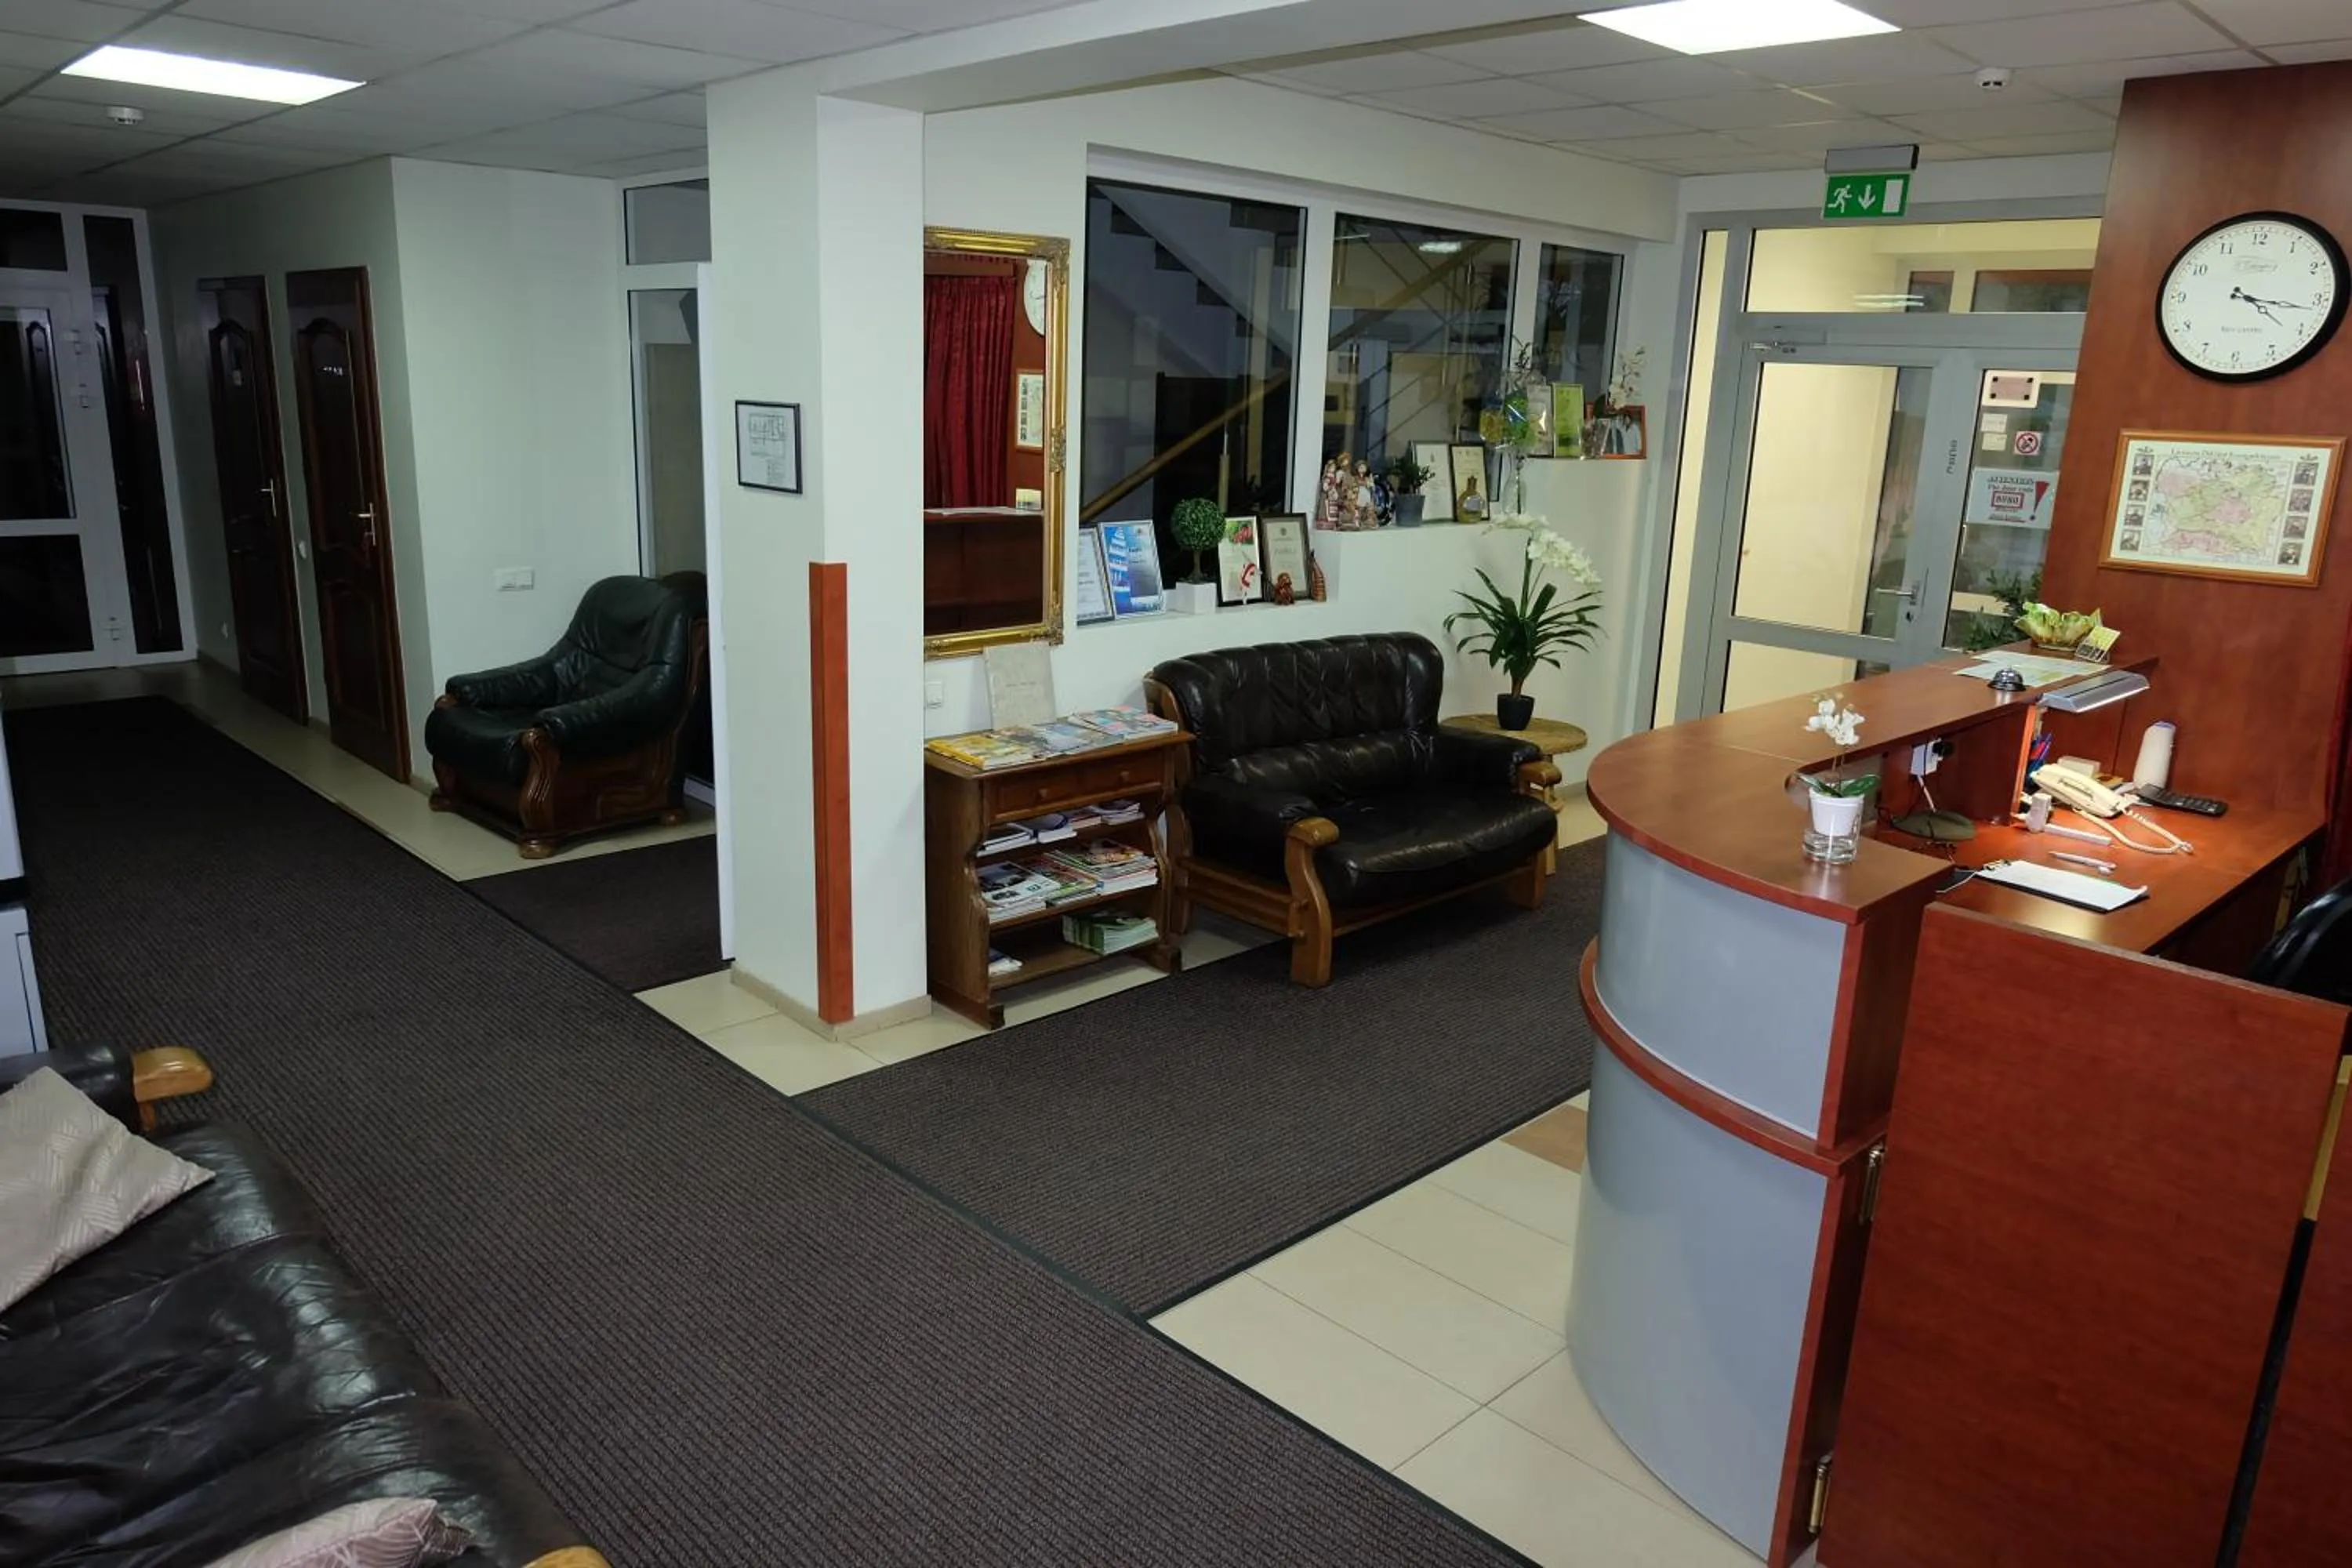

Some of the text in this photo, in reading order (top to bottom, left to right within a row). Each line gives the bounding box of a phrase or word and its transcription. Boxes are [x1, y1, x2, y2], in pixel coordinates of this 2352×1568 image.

[2252, 232, 2268, 245] 12
[2220, 242, 2233, 255] 11
[2192, 263, 2208, 276] 10
[2310, 261, 2318, 274] 2
[2312, 292, 2322, 306] 3
[2183, 319, 2192, 332] 8
[2201, 342, 2210, 354] 7
[2231, 350, 2241, 363] 6
